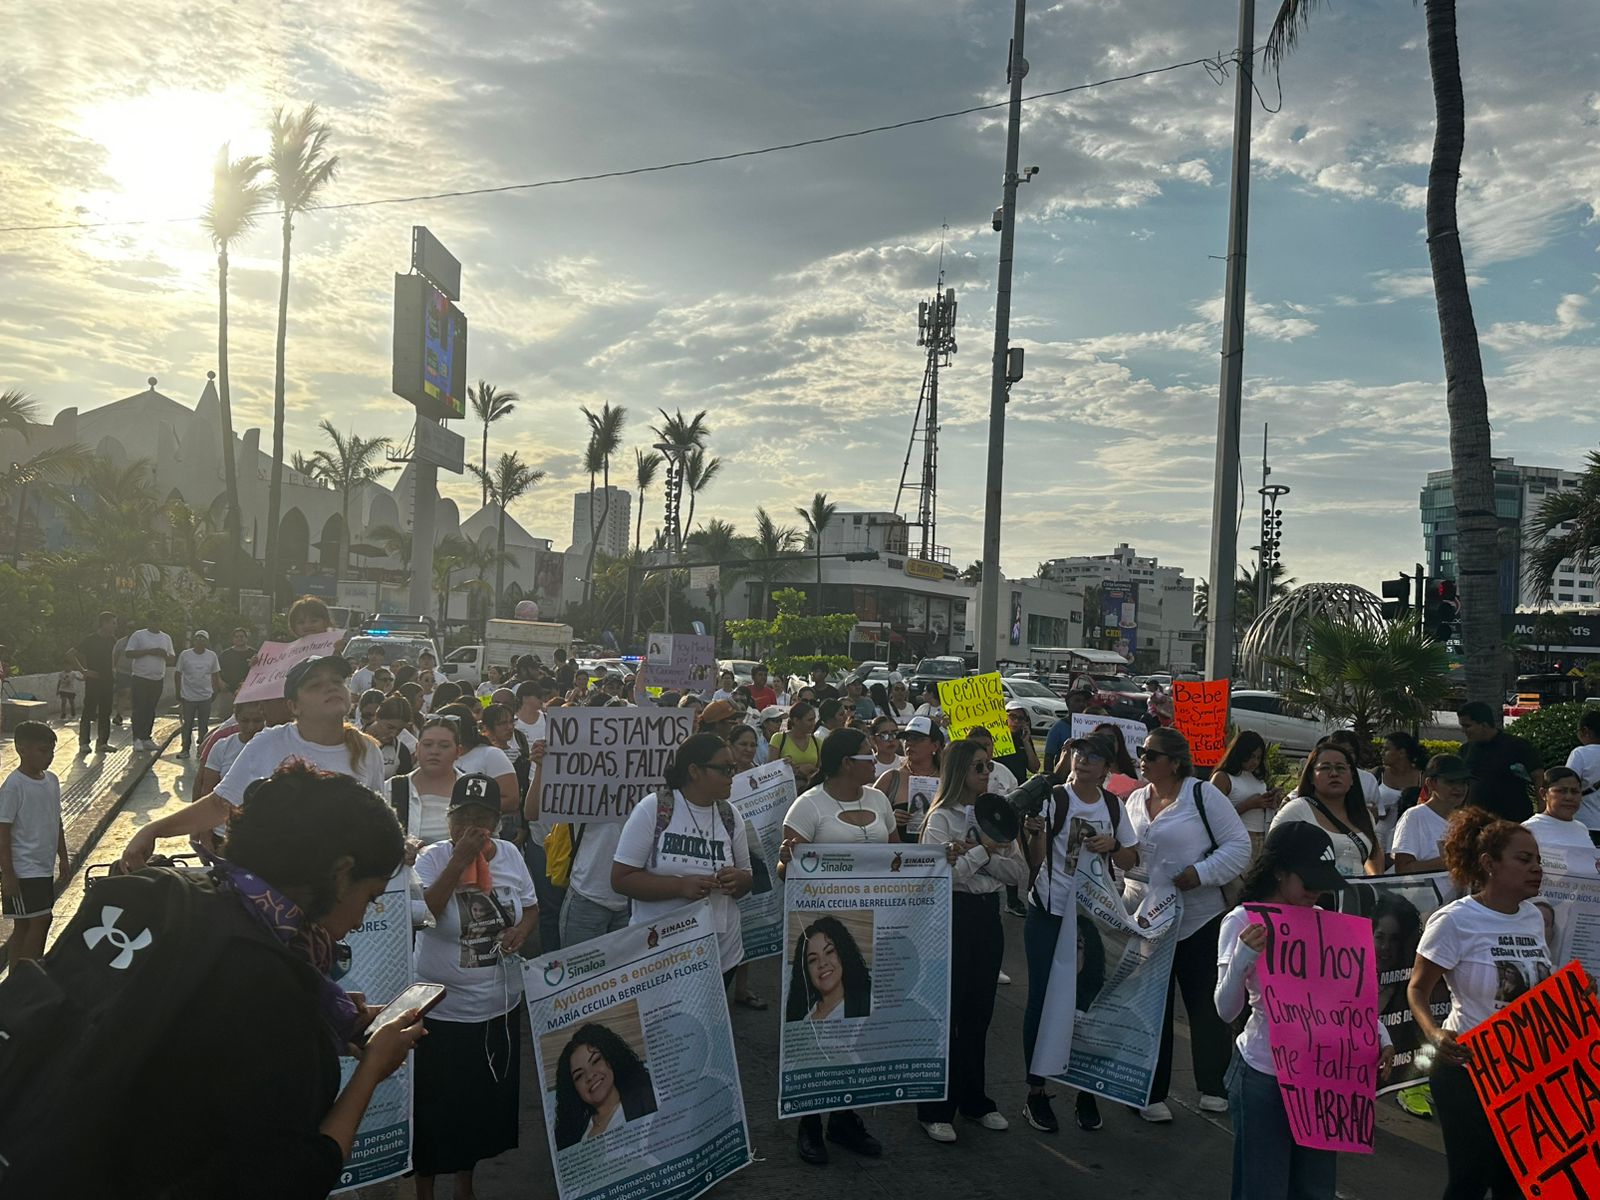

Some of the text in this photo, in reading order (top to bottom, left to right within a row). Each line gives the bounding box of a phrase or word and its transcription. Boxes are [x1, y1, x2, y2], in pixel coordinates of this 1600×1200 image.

[941, 676, 1002, 706] Cecilia
[550, 716, 689, 746] NO ESTAMOS
[551, 749, 676, 779] TODAS, FALTA
[542, 783, 609, 816] CECILIA
[662, 855, 689, 863] NEW
[821, 862, 853, 872] Sinaloa
[863, 885, 870, 894] a
[873, 883, 926, 894] encontrar
[827, 899, 858, 909] CECILIA
[859, 898, 907, 908] BERRELLEZA
[908, 897, 935, 906] FLORES
[1148, 894, 1176, 918] SINALOA
[661, 917, 697, 935] SINALOA
[1094, 906, 1122, 928] CECILIA
[620, 973, 629, 984] a
[631, 950, 692, 979] encontrar
[1315, 912, 1365, 998] hoy
[568, 959, 606, 979] Sinaloa
[1380, 968, 1414, 985] MARCH
[582, 994, 618, 1016] CECILIA
[618, 972, 673, 1000] BERRELLEZA
[674, 959, 709, 979] FLORES
[1265, 985, 1327, 1050] Cumplo
[1379, 1012, 1402, 1027] EMOS
[793, 1073, 812, 1081] tienes
[858, 1065, 886, 1074] referente
[1089, 1064, 1104, 1074] muy
[1272, 1045, 1300, 1080] me
[858, 1076, 878, 1085] ayuda
[887, 1073, 901, 1082] muy
[1280, 1083, 1376, 1147] TU ABRAZO
[650, 1180, 661, 1189] Tu
[662, 1171, 686, 1187] ayuda
[687, 1166, 697, 1174] es
[697, 1157, 709, 1172] muy
[658, 1157, 694, 1176] referente
[701, 1146, 715, 1156] esta
